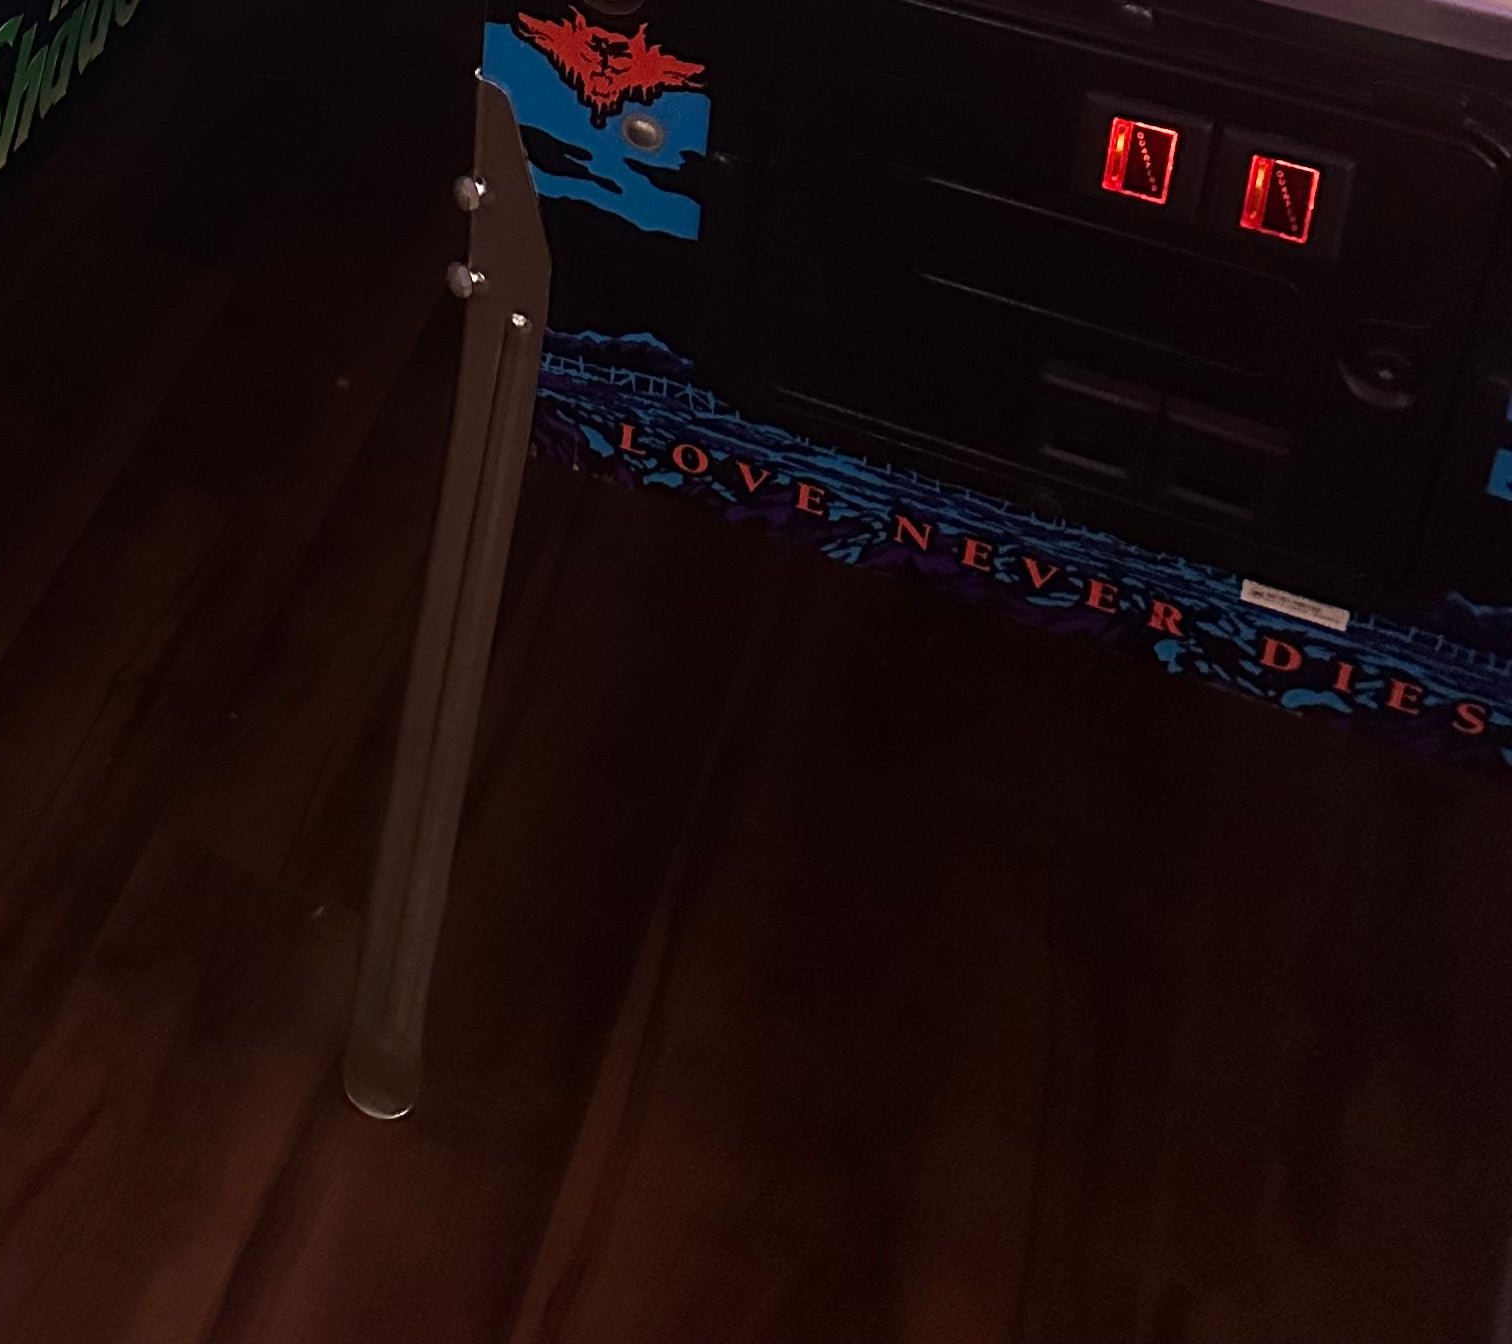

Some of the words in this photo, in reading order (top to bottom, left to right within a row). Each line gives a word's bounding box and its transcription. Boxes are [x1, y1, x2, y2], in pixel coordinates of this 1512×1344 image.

[620, 424, 828, 518] LOVE
[895, 515, 1183, 636] NEVER
[1261, 638, 1487, 736] DIES
